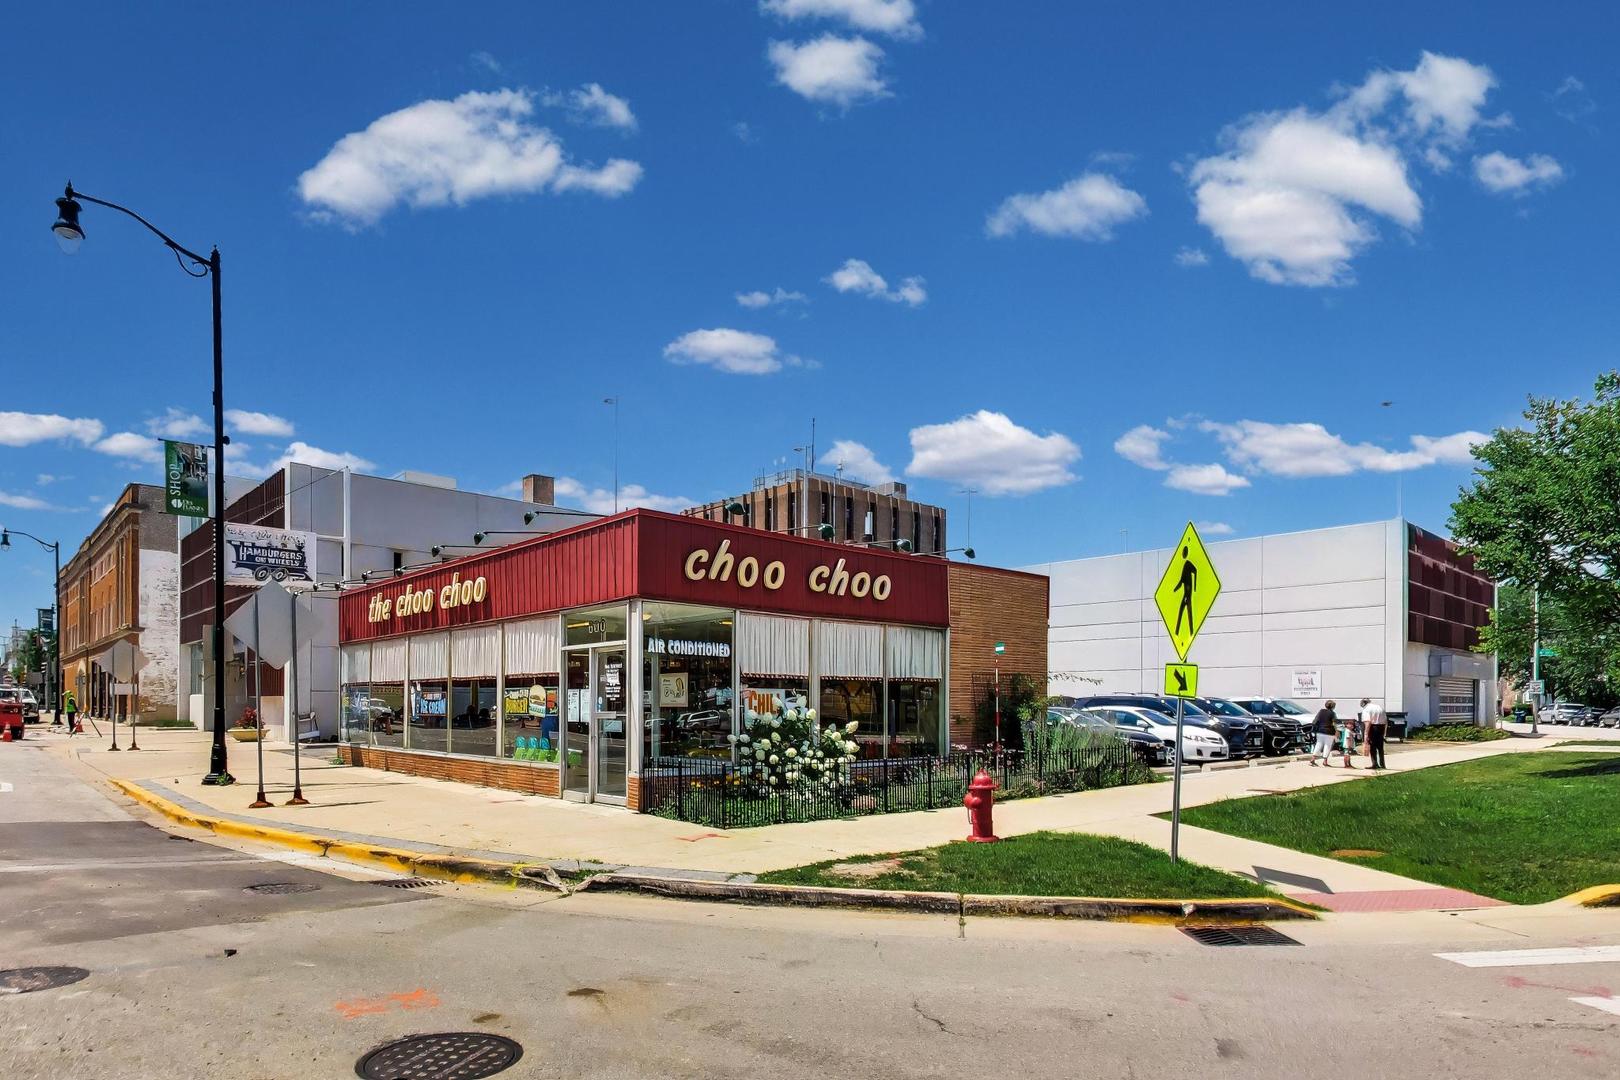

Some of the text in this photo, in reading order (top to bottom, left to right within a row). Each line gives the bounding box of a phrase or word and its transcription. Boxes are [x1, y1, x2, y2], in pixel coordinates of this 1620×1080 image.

[169, 463, 181, 496] SHOP
[239, 545, 303, 561] HAMBURGERS
[255, 556, 300, 567] ON WHEELS
[684, 539, 892, 601] choo choo
[368, 572, 487, 623] the choo choo
[647, 637, 731, 658] AIR CONDITIONED
[505, 697, 528, 714] BURGER
